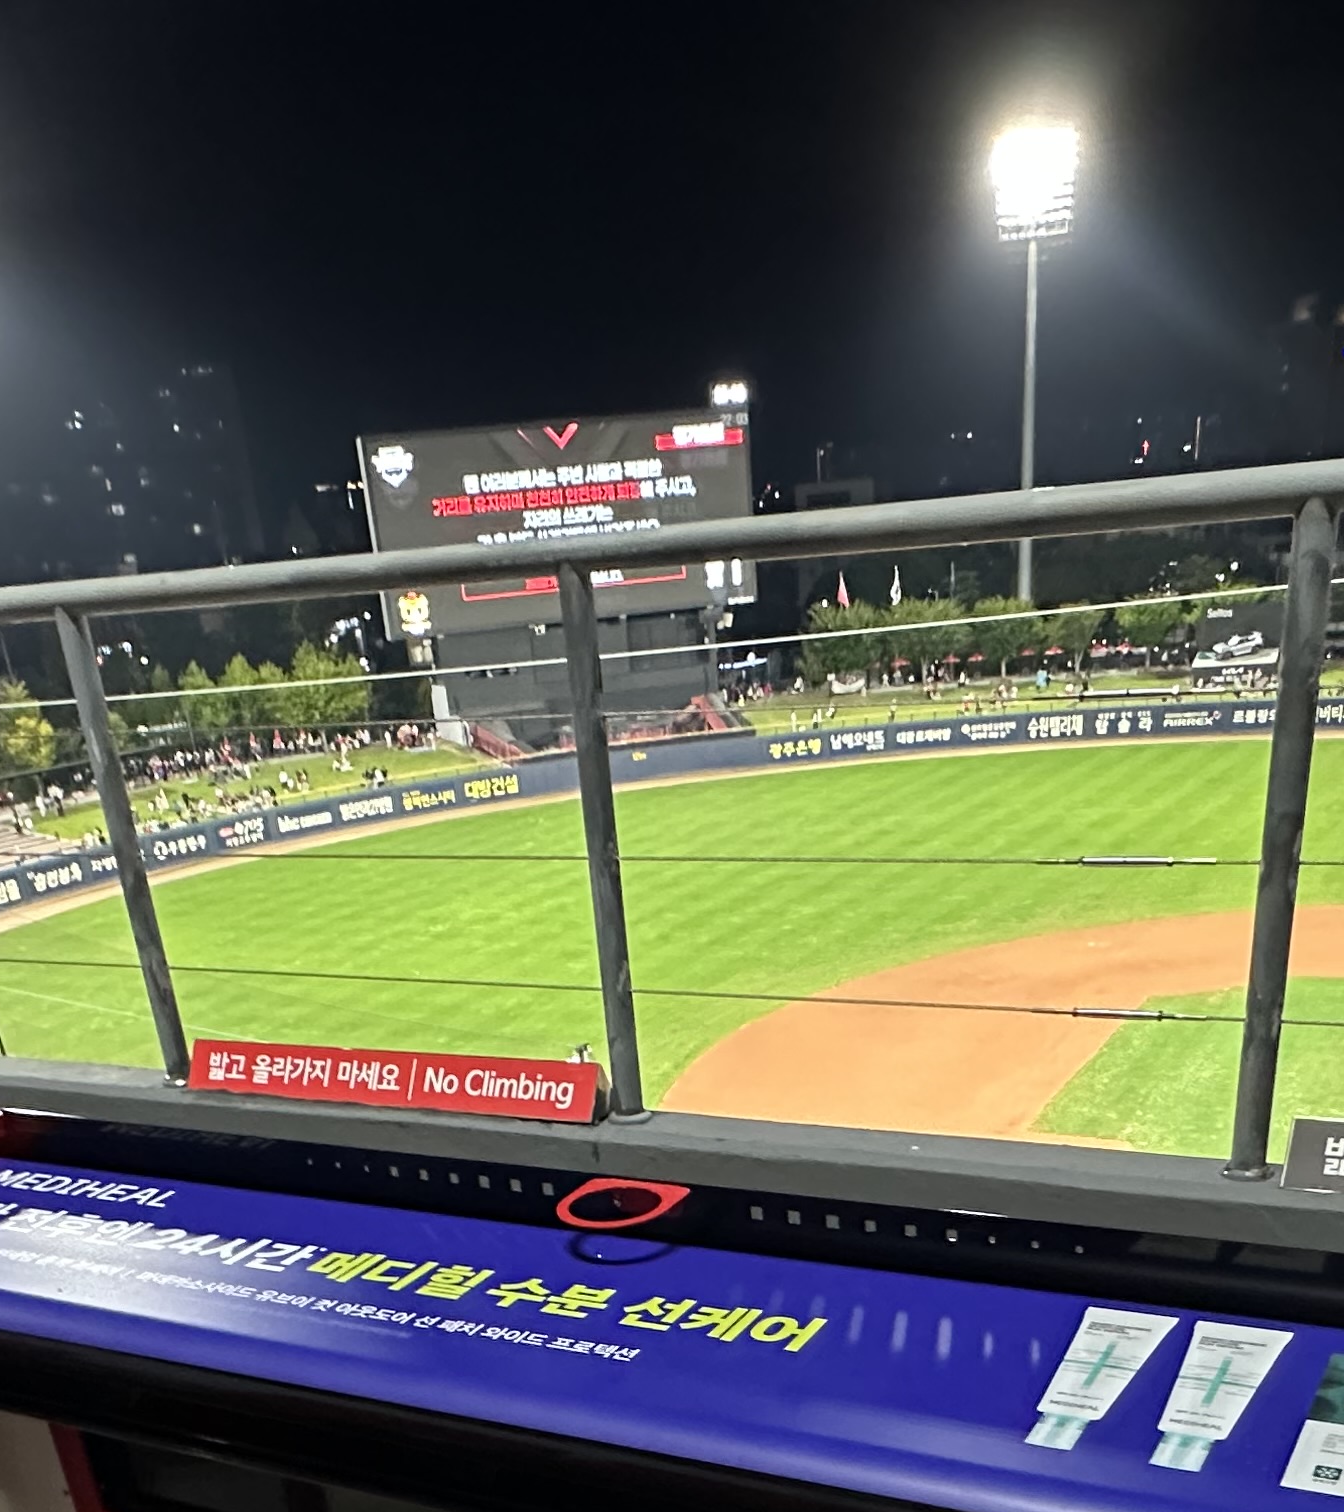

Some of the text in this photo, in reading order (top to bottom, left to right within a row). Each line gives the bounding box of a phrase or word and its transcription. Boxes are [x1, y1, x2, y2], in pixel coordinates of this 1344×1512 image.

[463, 774, 519, 799] 대방건설
[207, 1051, 575, 1110] 밟고 올라가지 마세요 No Climbing
[306, 1252, 496, 1301] 메디힐
[486, 1278, 617, 1319] 수분
[618, 1296, 829, 1353] 선케어
[310, 1299, 339, 1312] 컷
[335, 1303, 417, 1323] 아웃도어
[413, 1315, 441, 1329] 선
[437, 1319, 486, 1336] 패치
[480, 1326, 549, 1347] 와이드
[546, 1337, 641, 1363] 프로텍션
